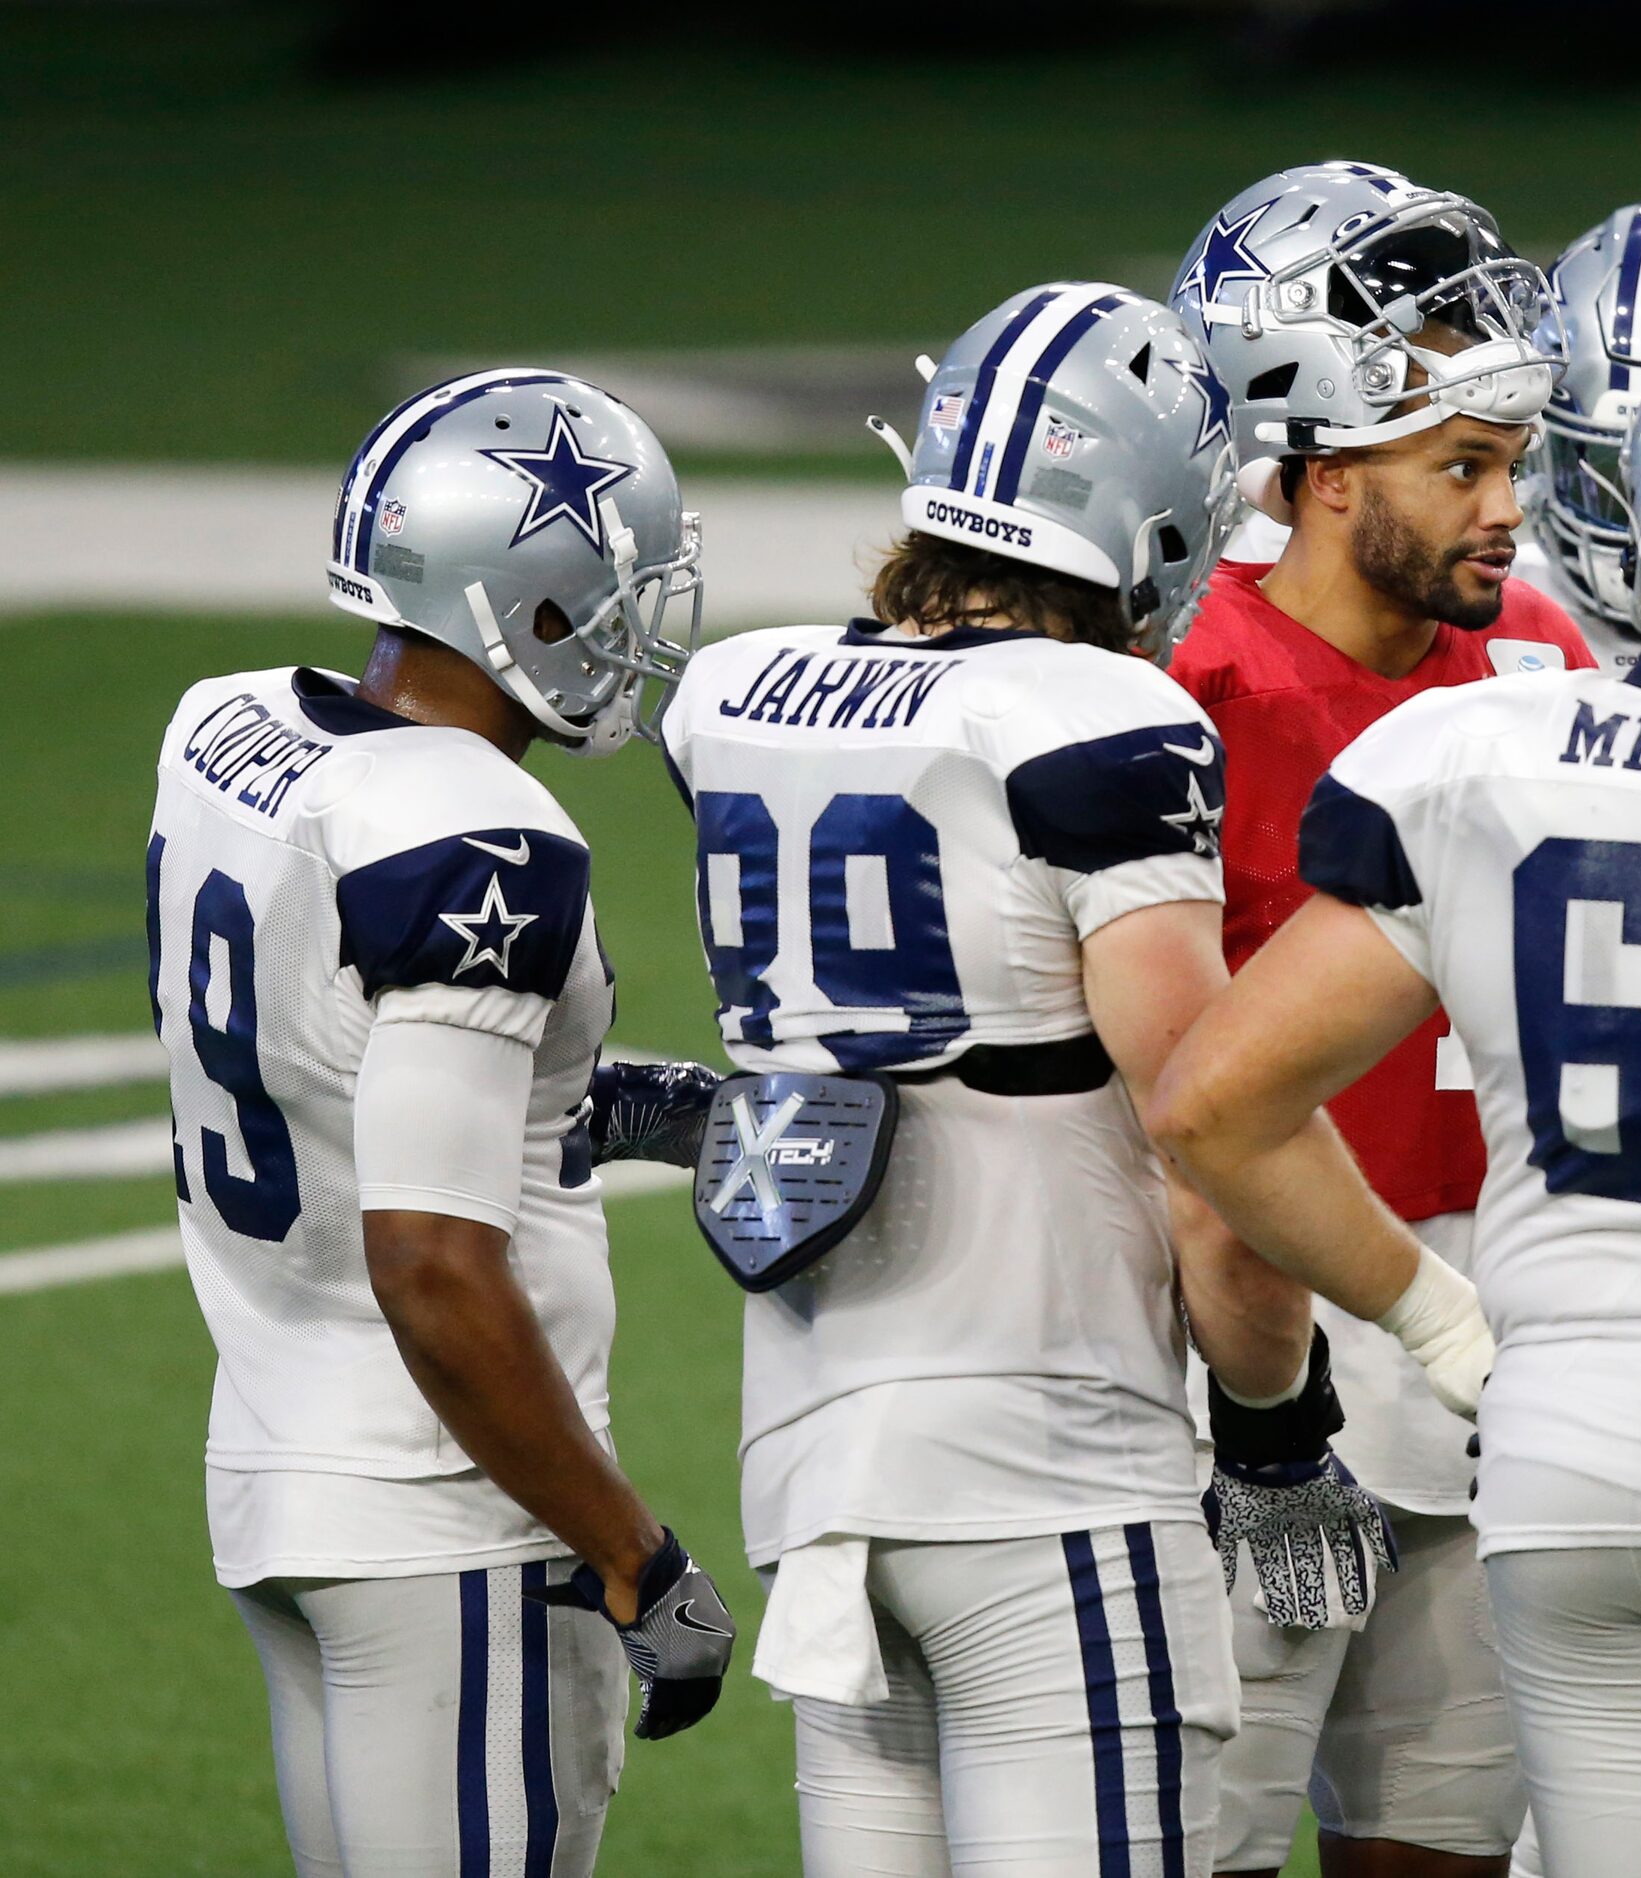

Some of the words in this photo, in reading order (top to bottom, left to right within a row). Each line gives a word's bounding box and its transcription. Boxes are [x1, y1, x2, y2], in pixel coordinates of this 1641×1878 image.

[382, 512, 401, 530] NFL
[926, 500, 1033, 547] COWBOYS
[719, 647, 966, 728] JARWIN
[184, 693, 333, 819] COOPER
[696, 790, 971, 1070] 89
